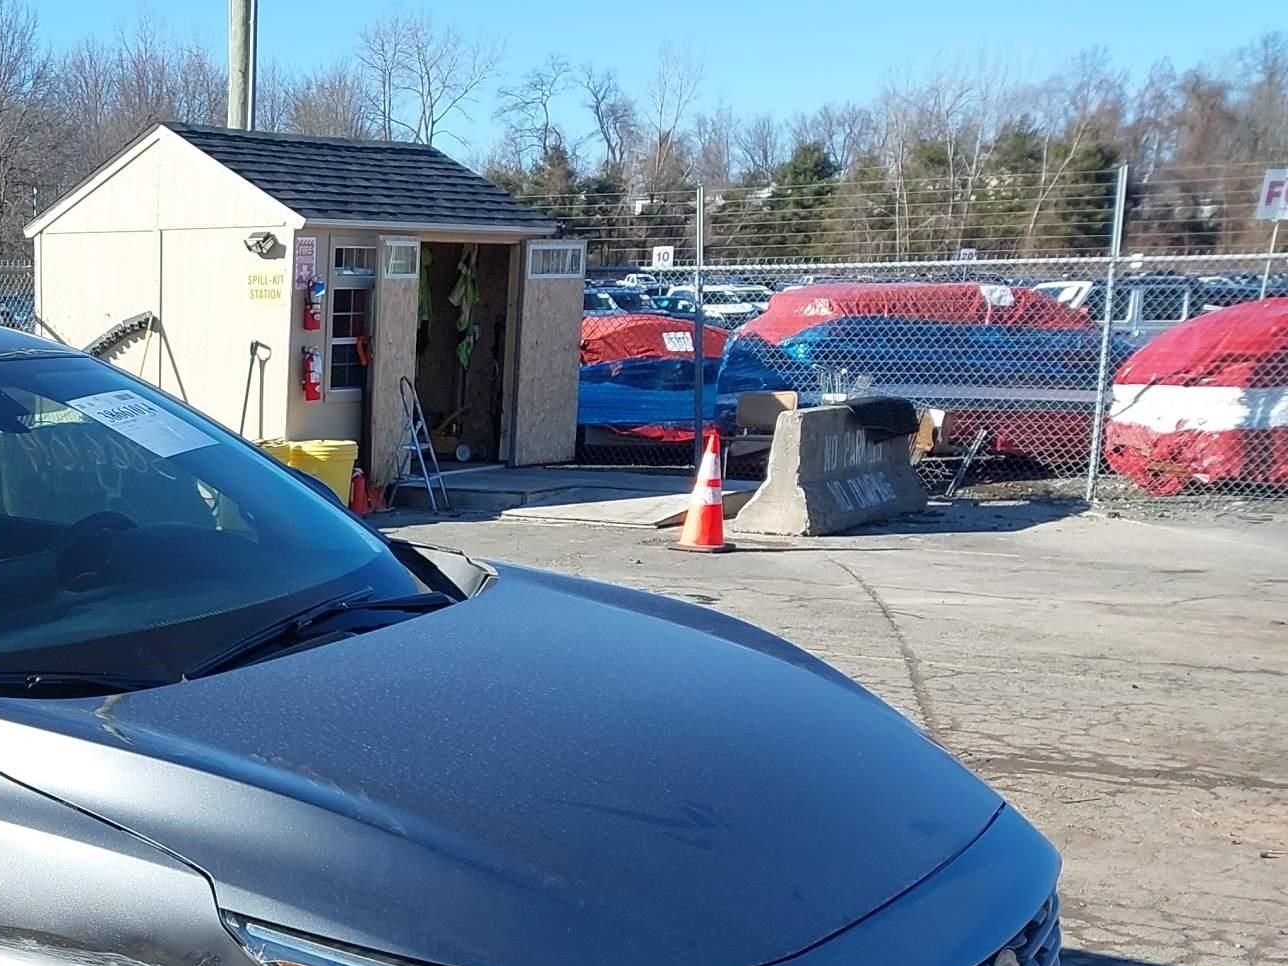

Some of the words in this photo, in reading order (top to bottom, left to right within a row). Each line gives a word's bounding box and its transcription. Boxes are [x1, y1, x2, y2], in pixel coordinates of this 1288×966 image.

[656, 250, 670, 262] 10
[247, 274, 285, 286] SPILL-KIT
[249, 288, 282, 300] STATION
